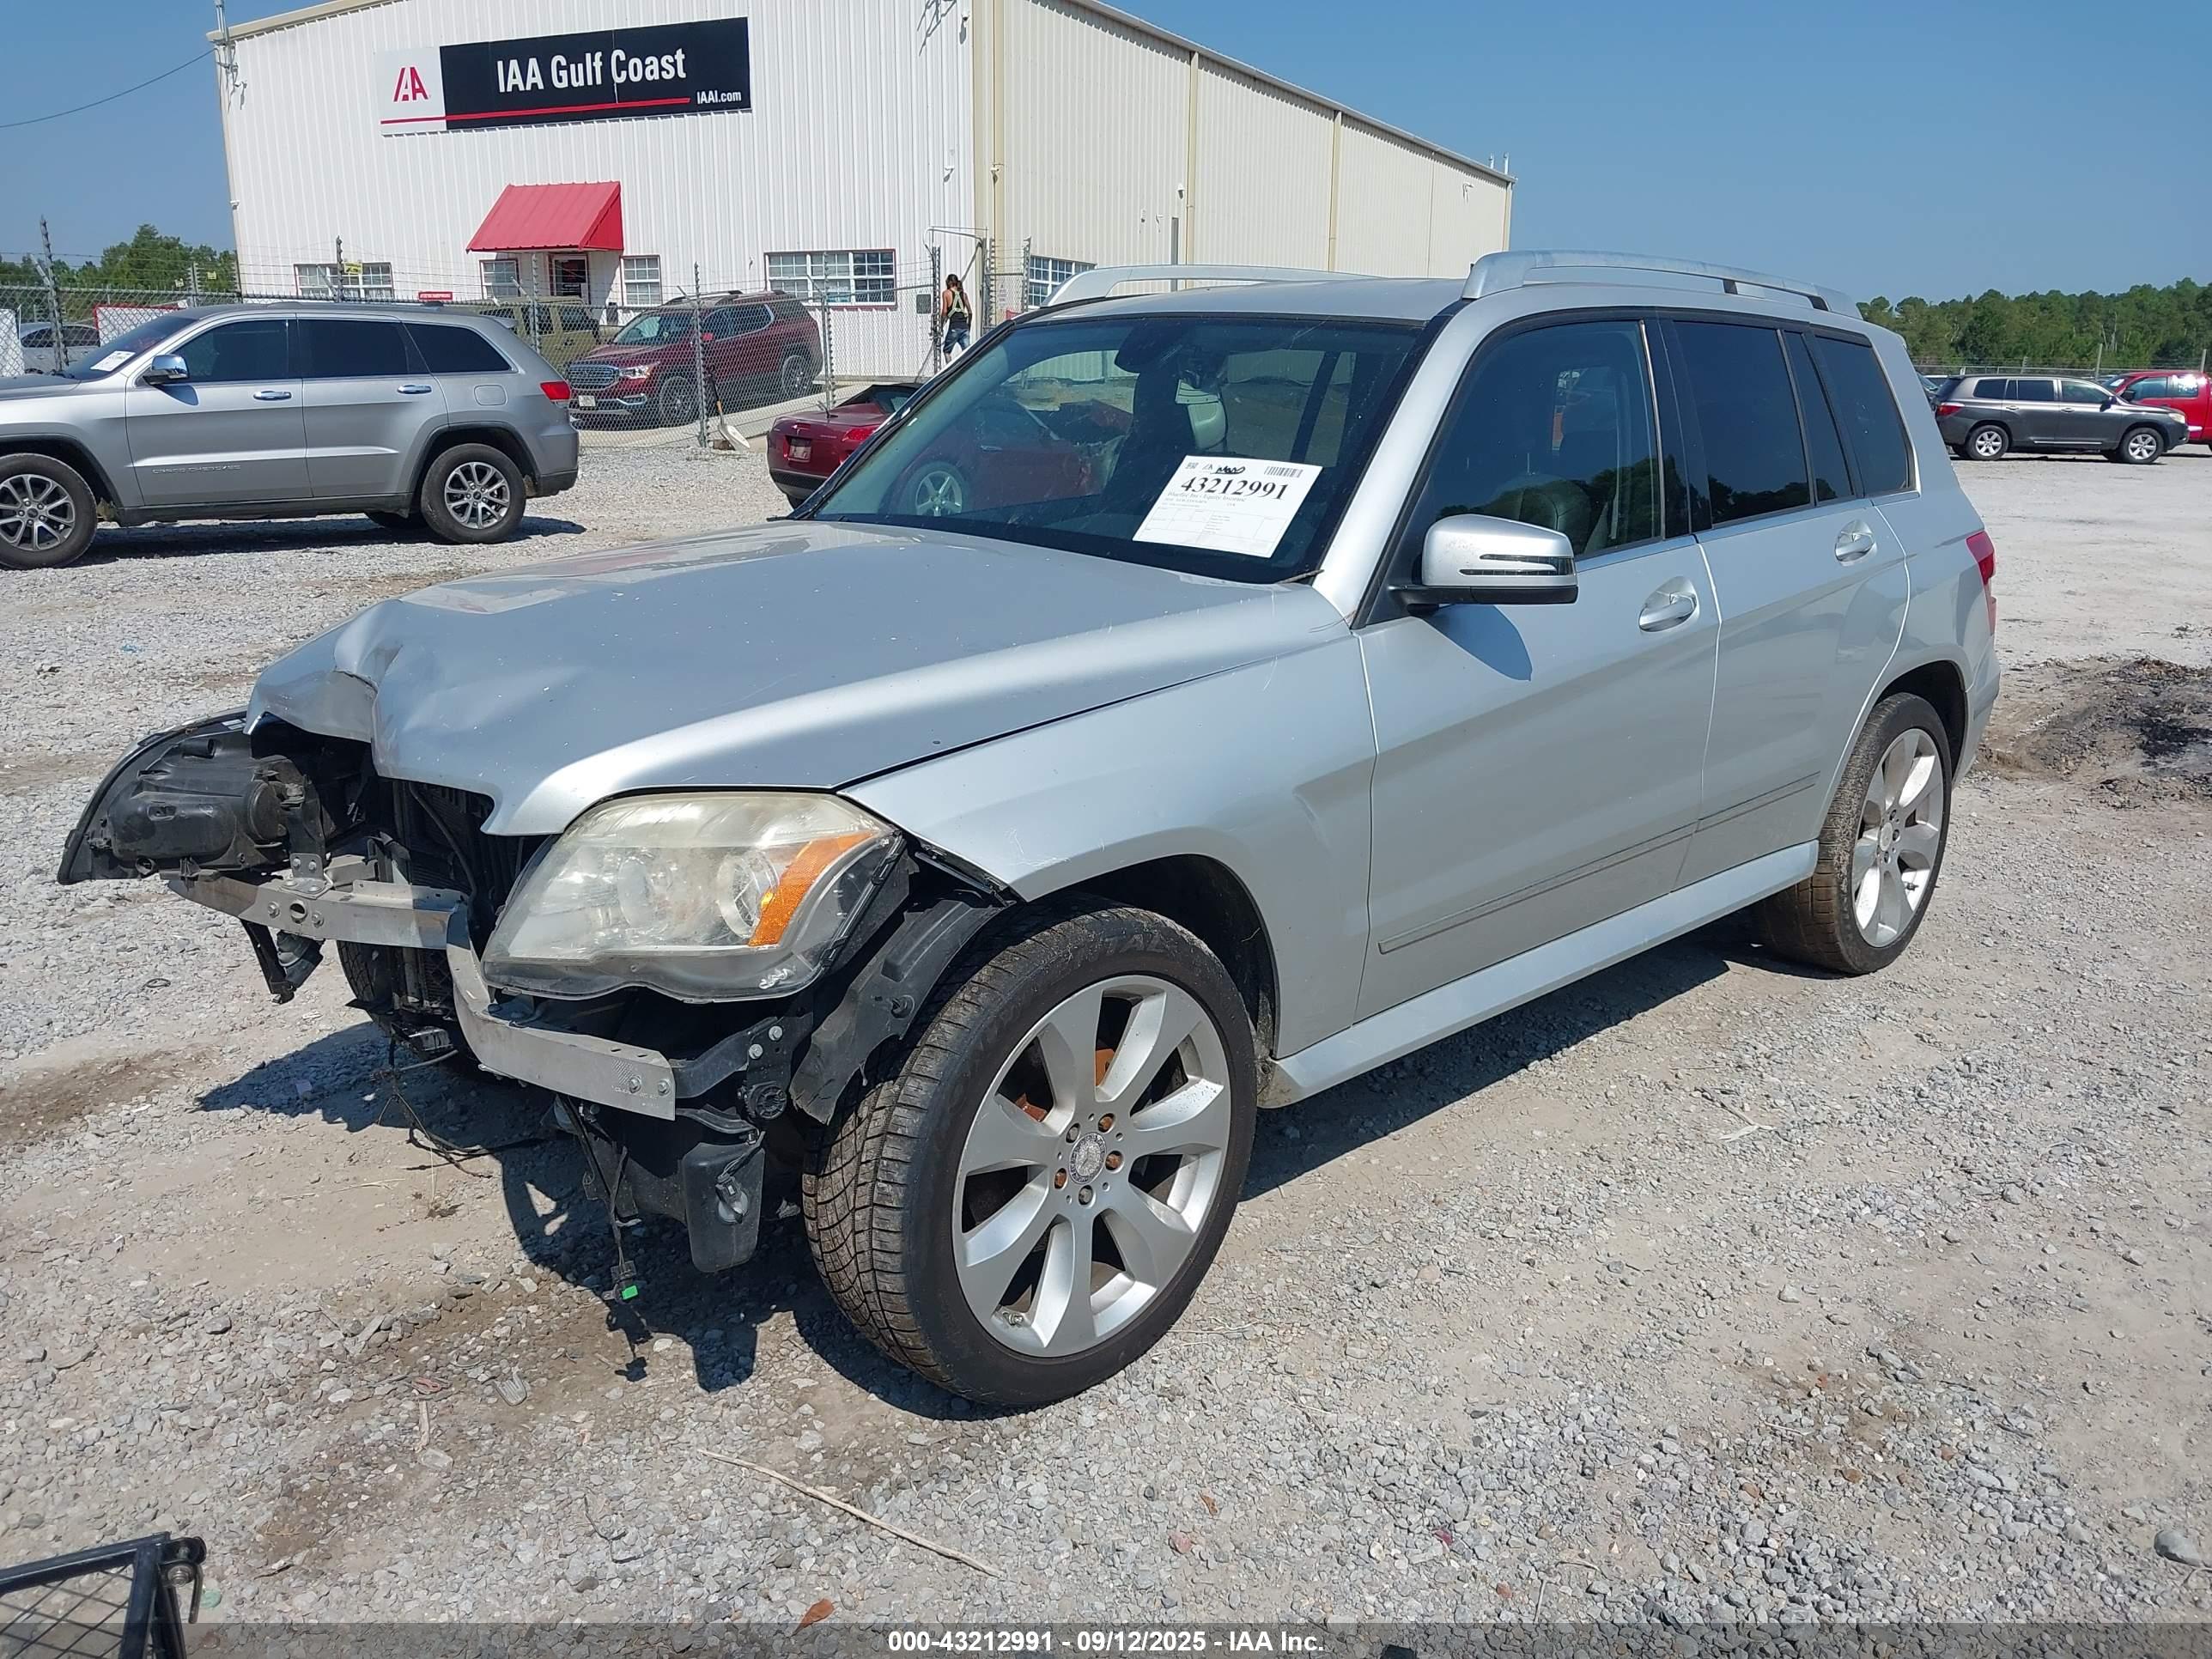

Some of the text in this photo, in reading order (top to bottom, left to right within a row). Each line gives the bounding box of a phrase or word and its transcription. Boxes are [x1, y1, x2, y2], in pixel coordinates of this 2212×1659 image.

[497, 48, 687, 93] IAA Gulf Coast
[696, 89, 742, 105] IAAI.com
[1181, 477, 1289, 500] 43212991
